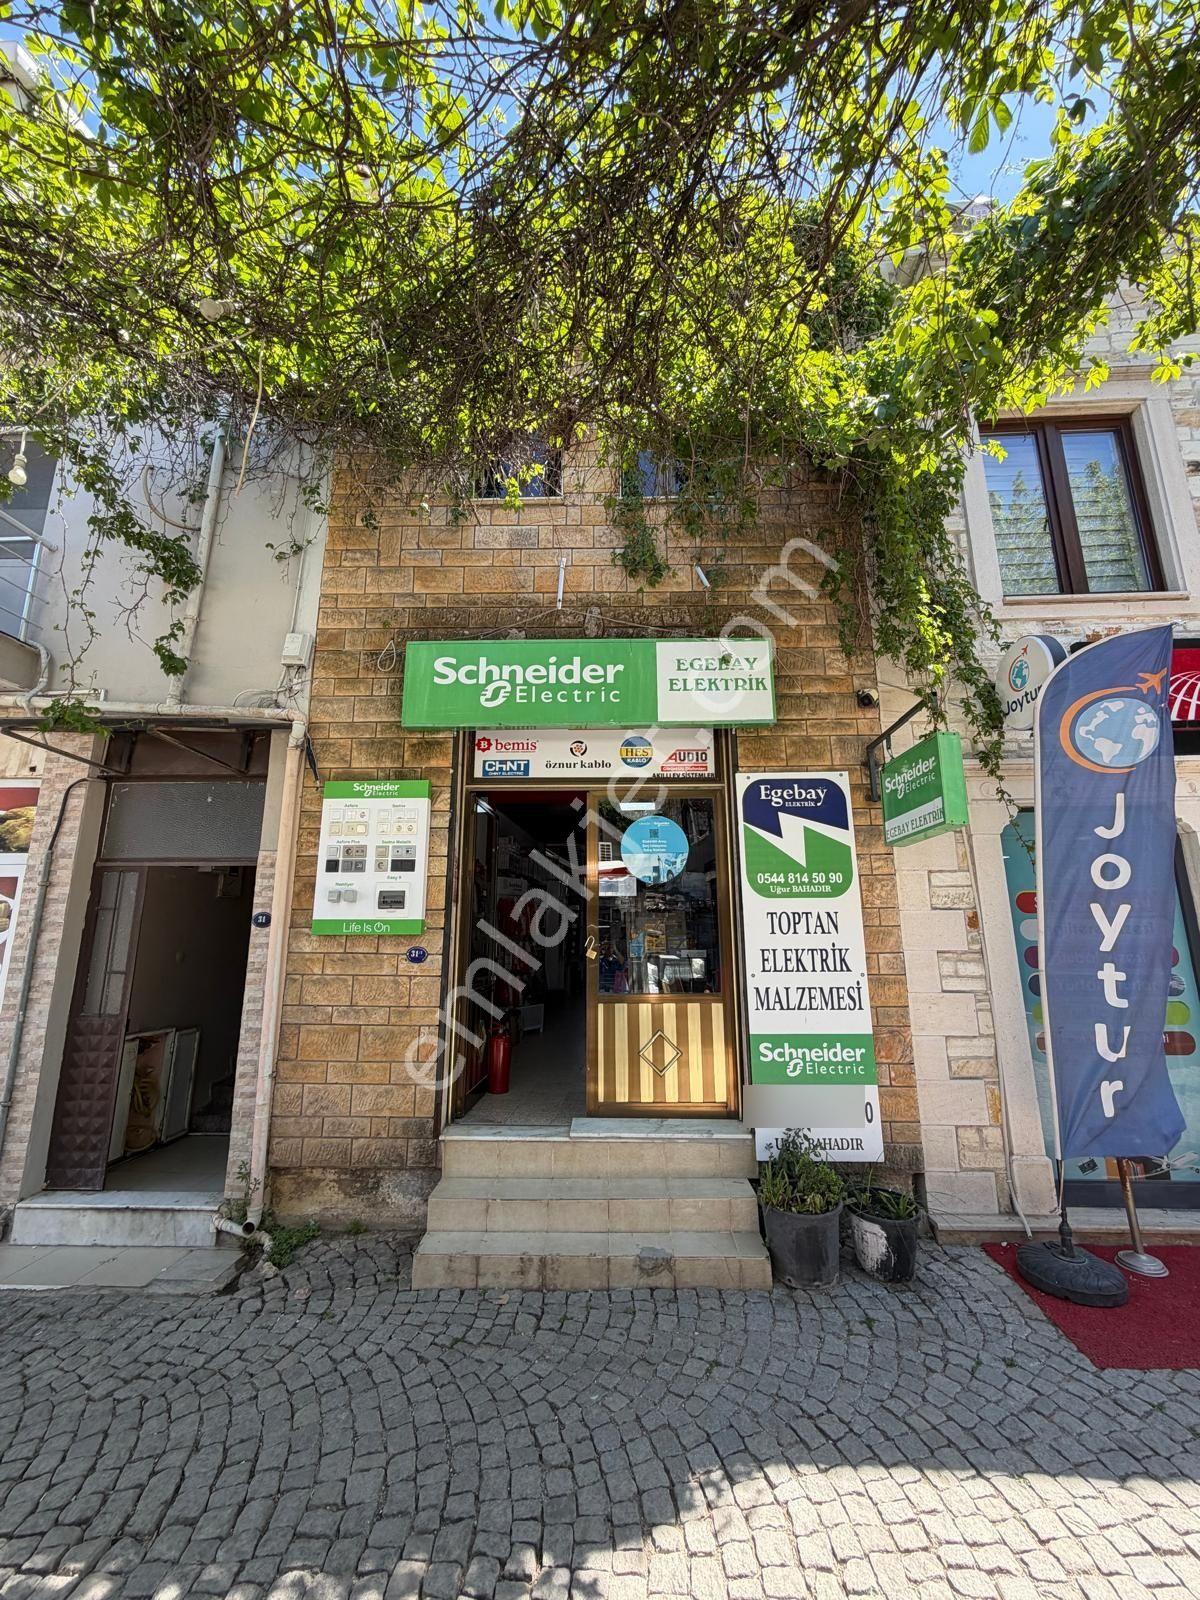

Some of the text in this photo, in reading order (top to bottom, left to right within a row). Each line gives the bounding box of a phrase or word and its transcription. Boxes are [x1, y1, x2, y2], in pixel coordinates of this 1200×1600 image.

[433, 656, 624, 685] Schneider
[675, 656, 758, 672] EGEBAY
[668, 674, 768, 692] ELEKTRİK
[515, 685, 621, 703] Electric
[495, 738, 537, 751] bemis
[625, 748, 649, 757] HES
[545, 760, 612, 769] öznur kablo
[665, 751, 708, 763] AUDIO
[885, 755, 936, 793] Schneider
[905, 772, 936, 793] Electric
[353, 783, 400, 792] Schneider
[759, 784, 827, 807] Egebay
[886, 821, 910, 840] EGEBAY
[757, 872, 843, 884] 0544 814 50 90
[770, 885, 832, 894] Uğur BAHADIR
[343, 922, 391, 933] Life Is On
[766, 911, 839, 935] TOPTAN
[760, 942, 852, 973] ELEKTRİK
[754, 980, 864, 1011] MALZEMESİ
[758, 1042, 866, 1062] Schneider
[806, 1063, 865, 1075] Electric
